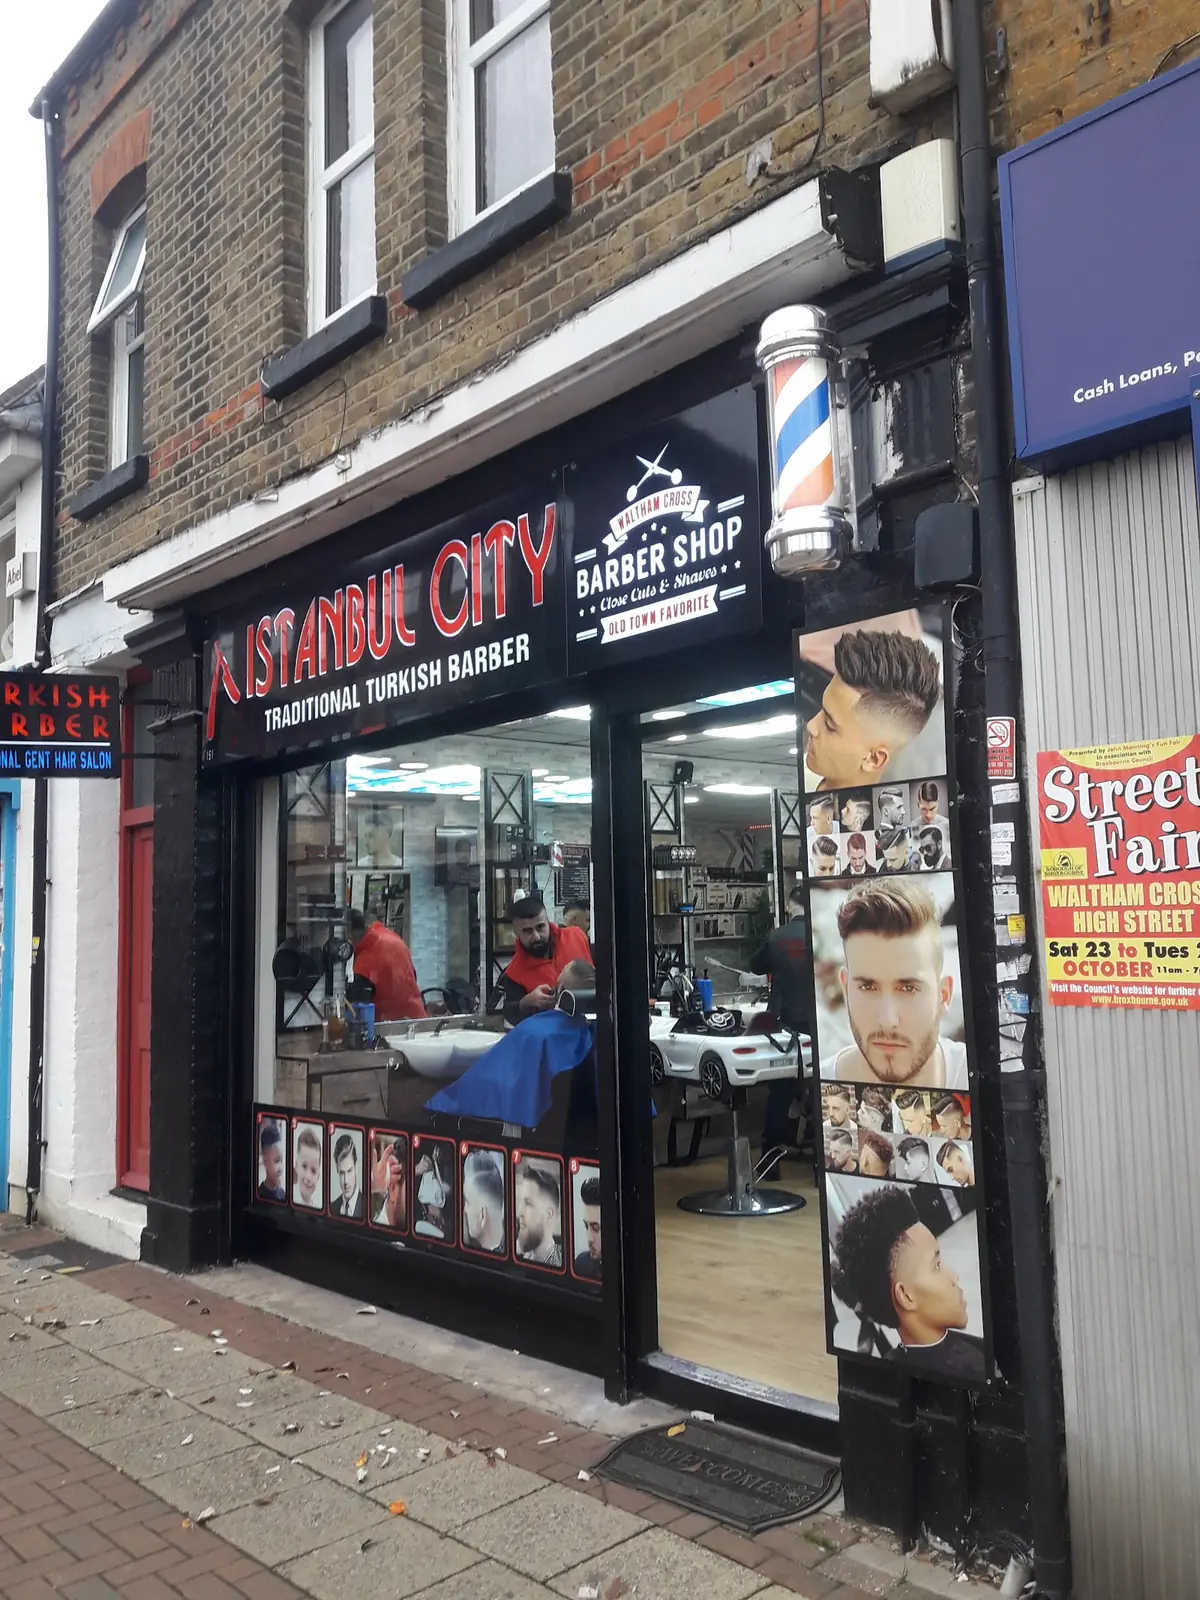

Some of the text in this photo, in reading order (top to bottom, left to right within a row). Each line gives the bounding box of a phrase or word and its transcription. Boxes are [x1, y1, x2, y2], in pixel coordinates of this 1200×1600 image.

[1073, 379, 1114, 403] Cash
[1119, 362, 1178, 389] Loans,
[616, 490, 693, 531] WALTHAM CROSS
[576, 515, 742, 599] BARBER SHOP
[7, 562, 22, 586] Abel
[246, 502, 556, 699] ISTANBUL CITY
[600, 566, 718, 612] Close Cuts & Shaves
[608, 594, 710, 636] OLD TOWN FAVORITE
[264, 633, 530, 732] TRADITIONAL TURKISH BARBER
[0, 750, 112, 769] NAL GENT HAIR SALON
[1069, 748, 1097, 756] Presented
[1104, 751, 1137, 759] association
[1043, 756, 1200, 823] Street
[1047, 883, 1145, 908] WALTHAM
[1073, 909, 1195, 933] HIGH STREET
[1049, 941, 1079, 957] Sat
[1085, 941, 1111, 957] 23
[1117, 943, 1137, 958] to
[1144, 941, 1189, 958] Tues
[1063, 960, 1154, 978] OCTOBER
[1156, 966, 1183, 974] 11am
[1050, 983, 1068, 993] Visit
[1069, 983, 1082, 993] the
[1083, 984, 1119, 994] Council's
[1121, 985, 1153, 995] website
[1154, 986, 1167, 995] for
[1168, 986, 1196, 996] further
[1091, 995, 1189, 1006] www.broxbourne.gov.uk
